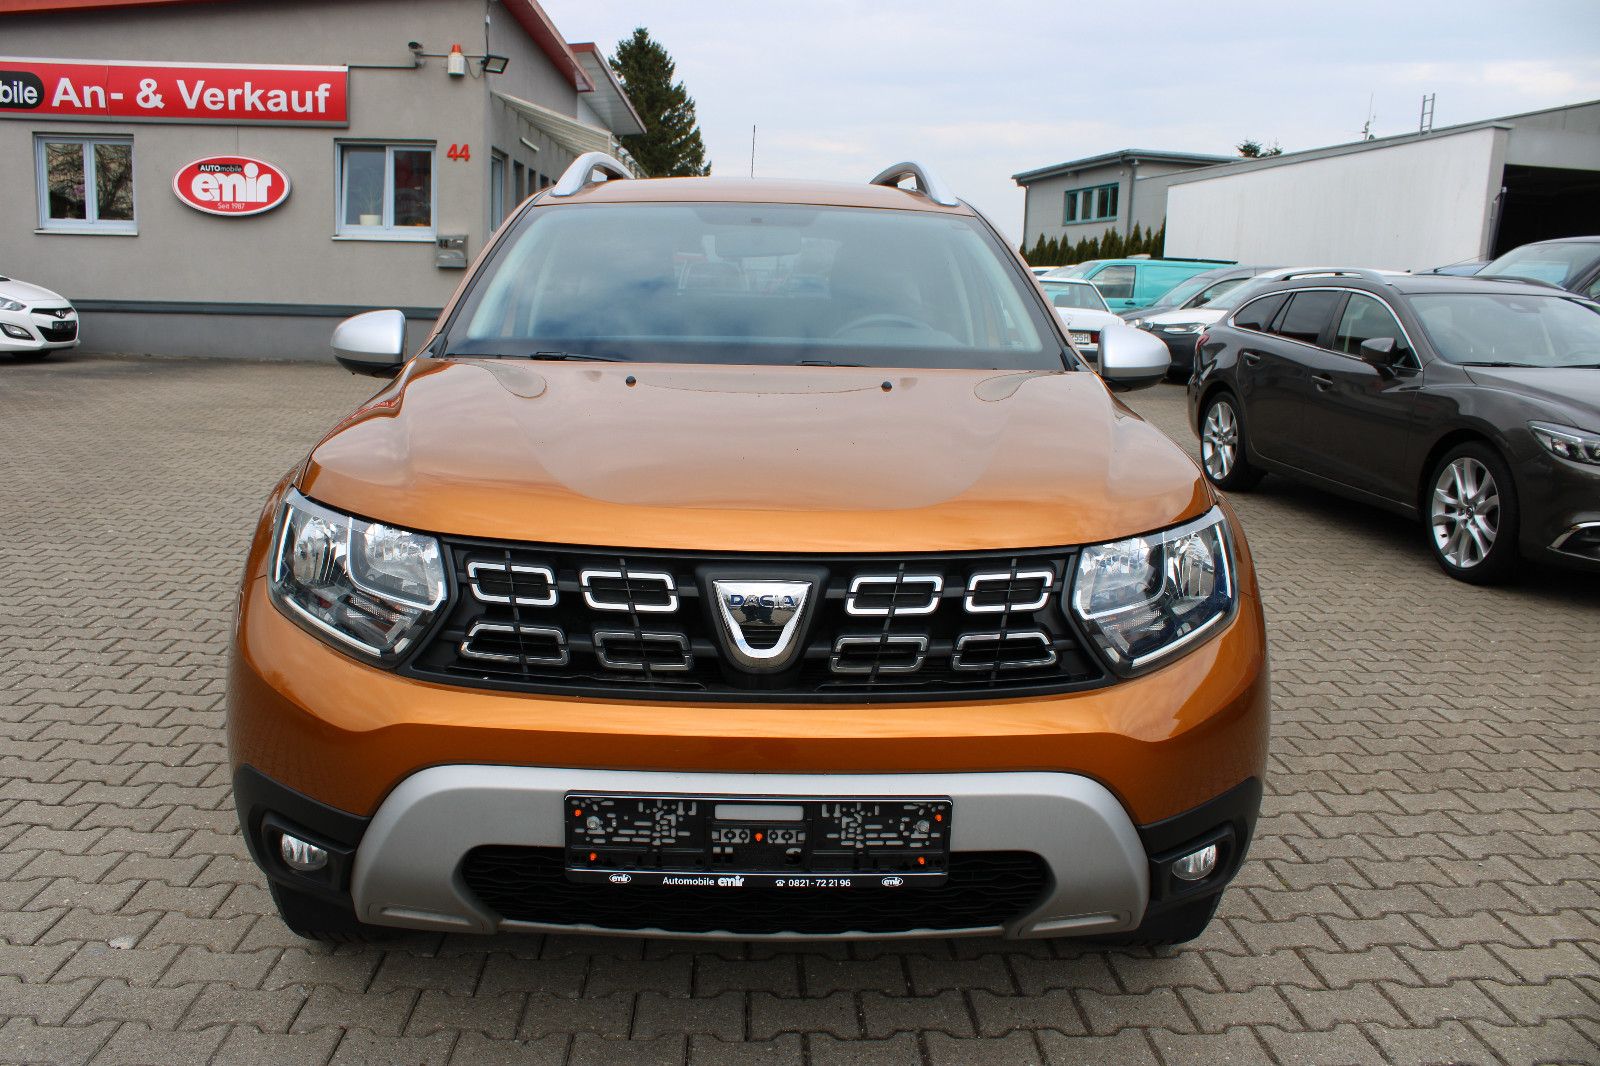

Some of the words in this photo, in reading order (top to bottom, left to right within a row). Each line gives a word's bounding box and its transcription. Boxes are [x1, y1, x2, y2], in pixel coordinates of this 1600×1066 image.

[51, 77, 124, 108] An-
[136, 78, 165, 109] &
[176, 79, 331, 113] Verkauf
[447, 144, 470, 161] 44
[200, 164, 242, 172] AUTOmobile
[191, 162, 272, 203] emir
[730, 594, 796, 608] DACIA
[662, 876, 715, 886] Automobile
[717, 875, 745, 887] emir
